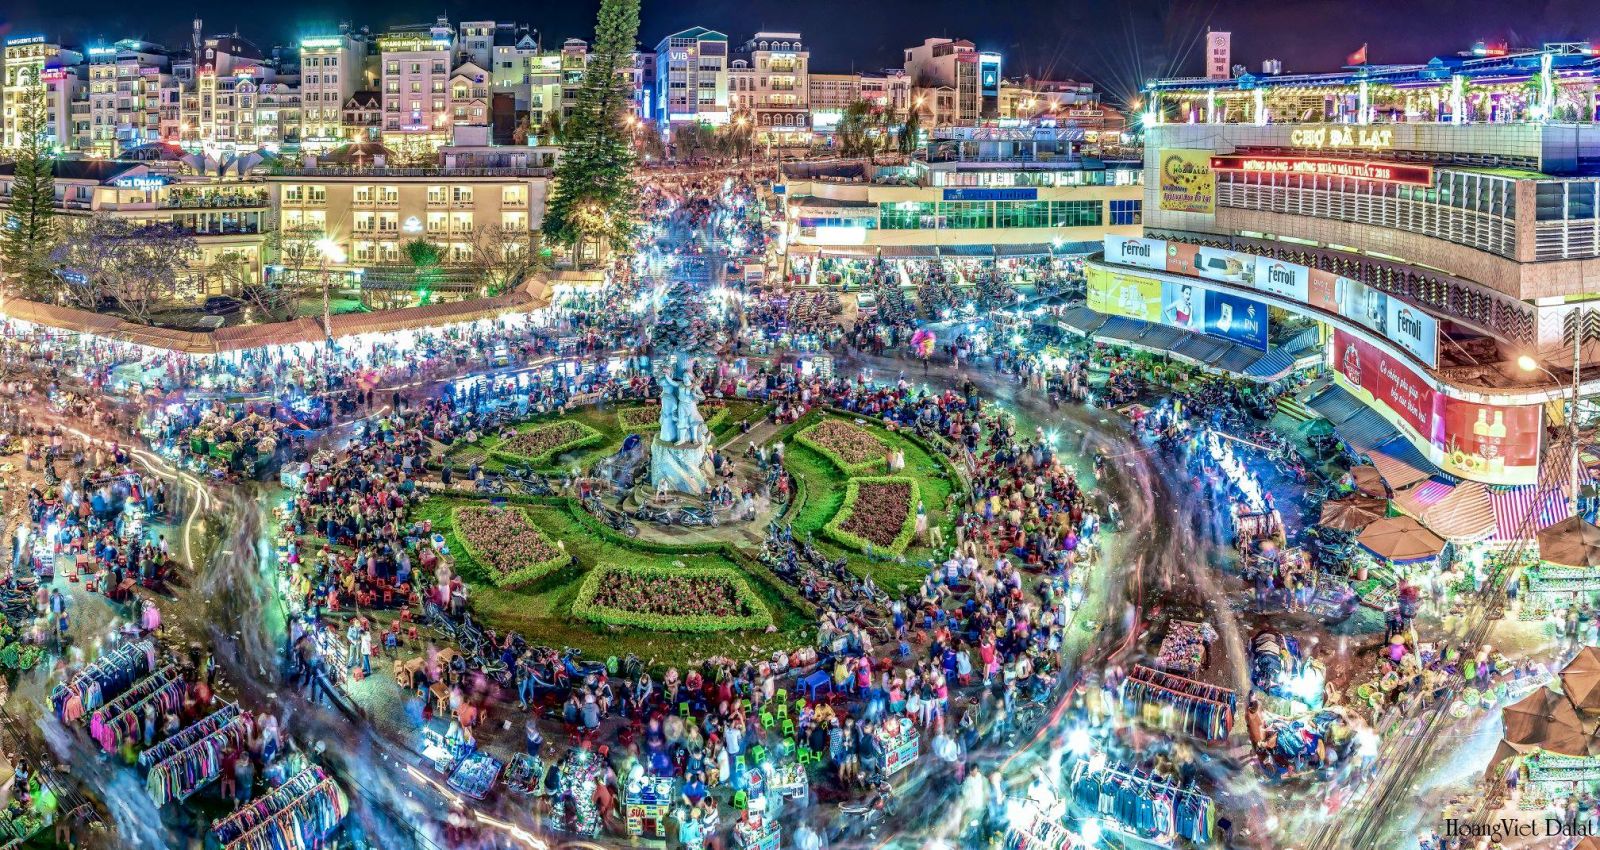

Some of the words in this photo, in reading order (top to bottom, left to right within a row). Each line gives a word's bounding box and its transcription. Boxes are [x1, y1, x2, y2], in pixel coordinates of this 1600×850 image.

[672, 52, 688, 60] VIB
[1375, 168, 1390, 179] 2018
[1122, 242, 1150, 257] Ferroli
[1268, 266, 1295, 286] Ferroli
[1245, 318, 1258, 335] PNJ
[1398, 310, 1421, 341] Ferroli
